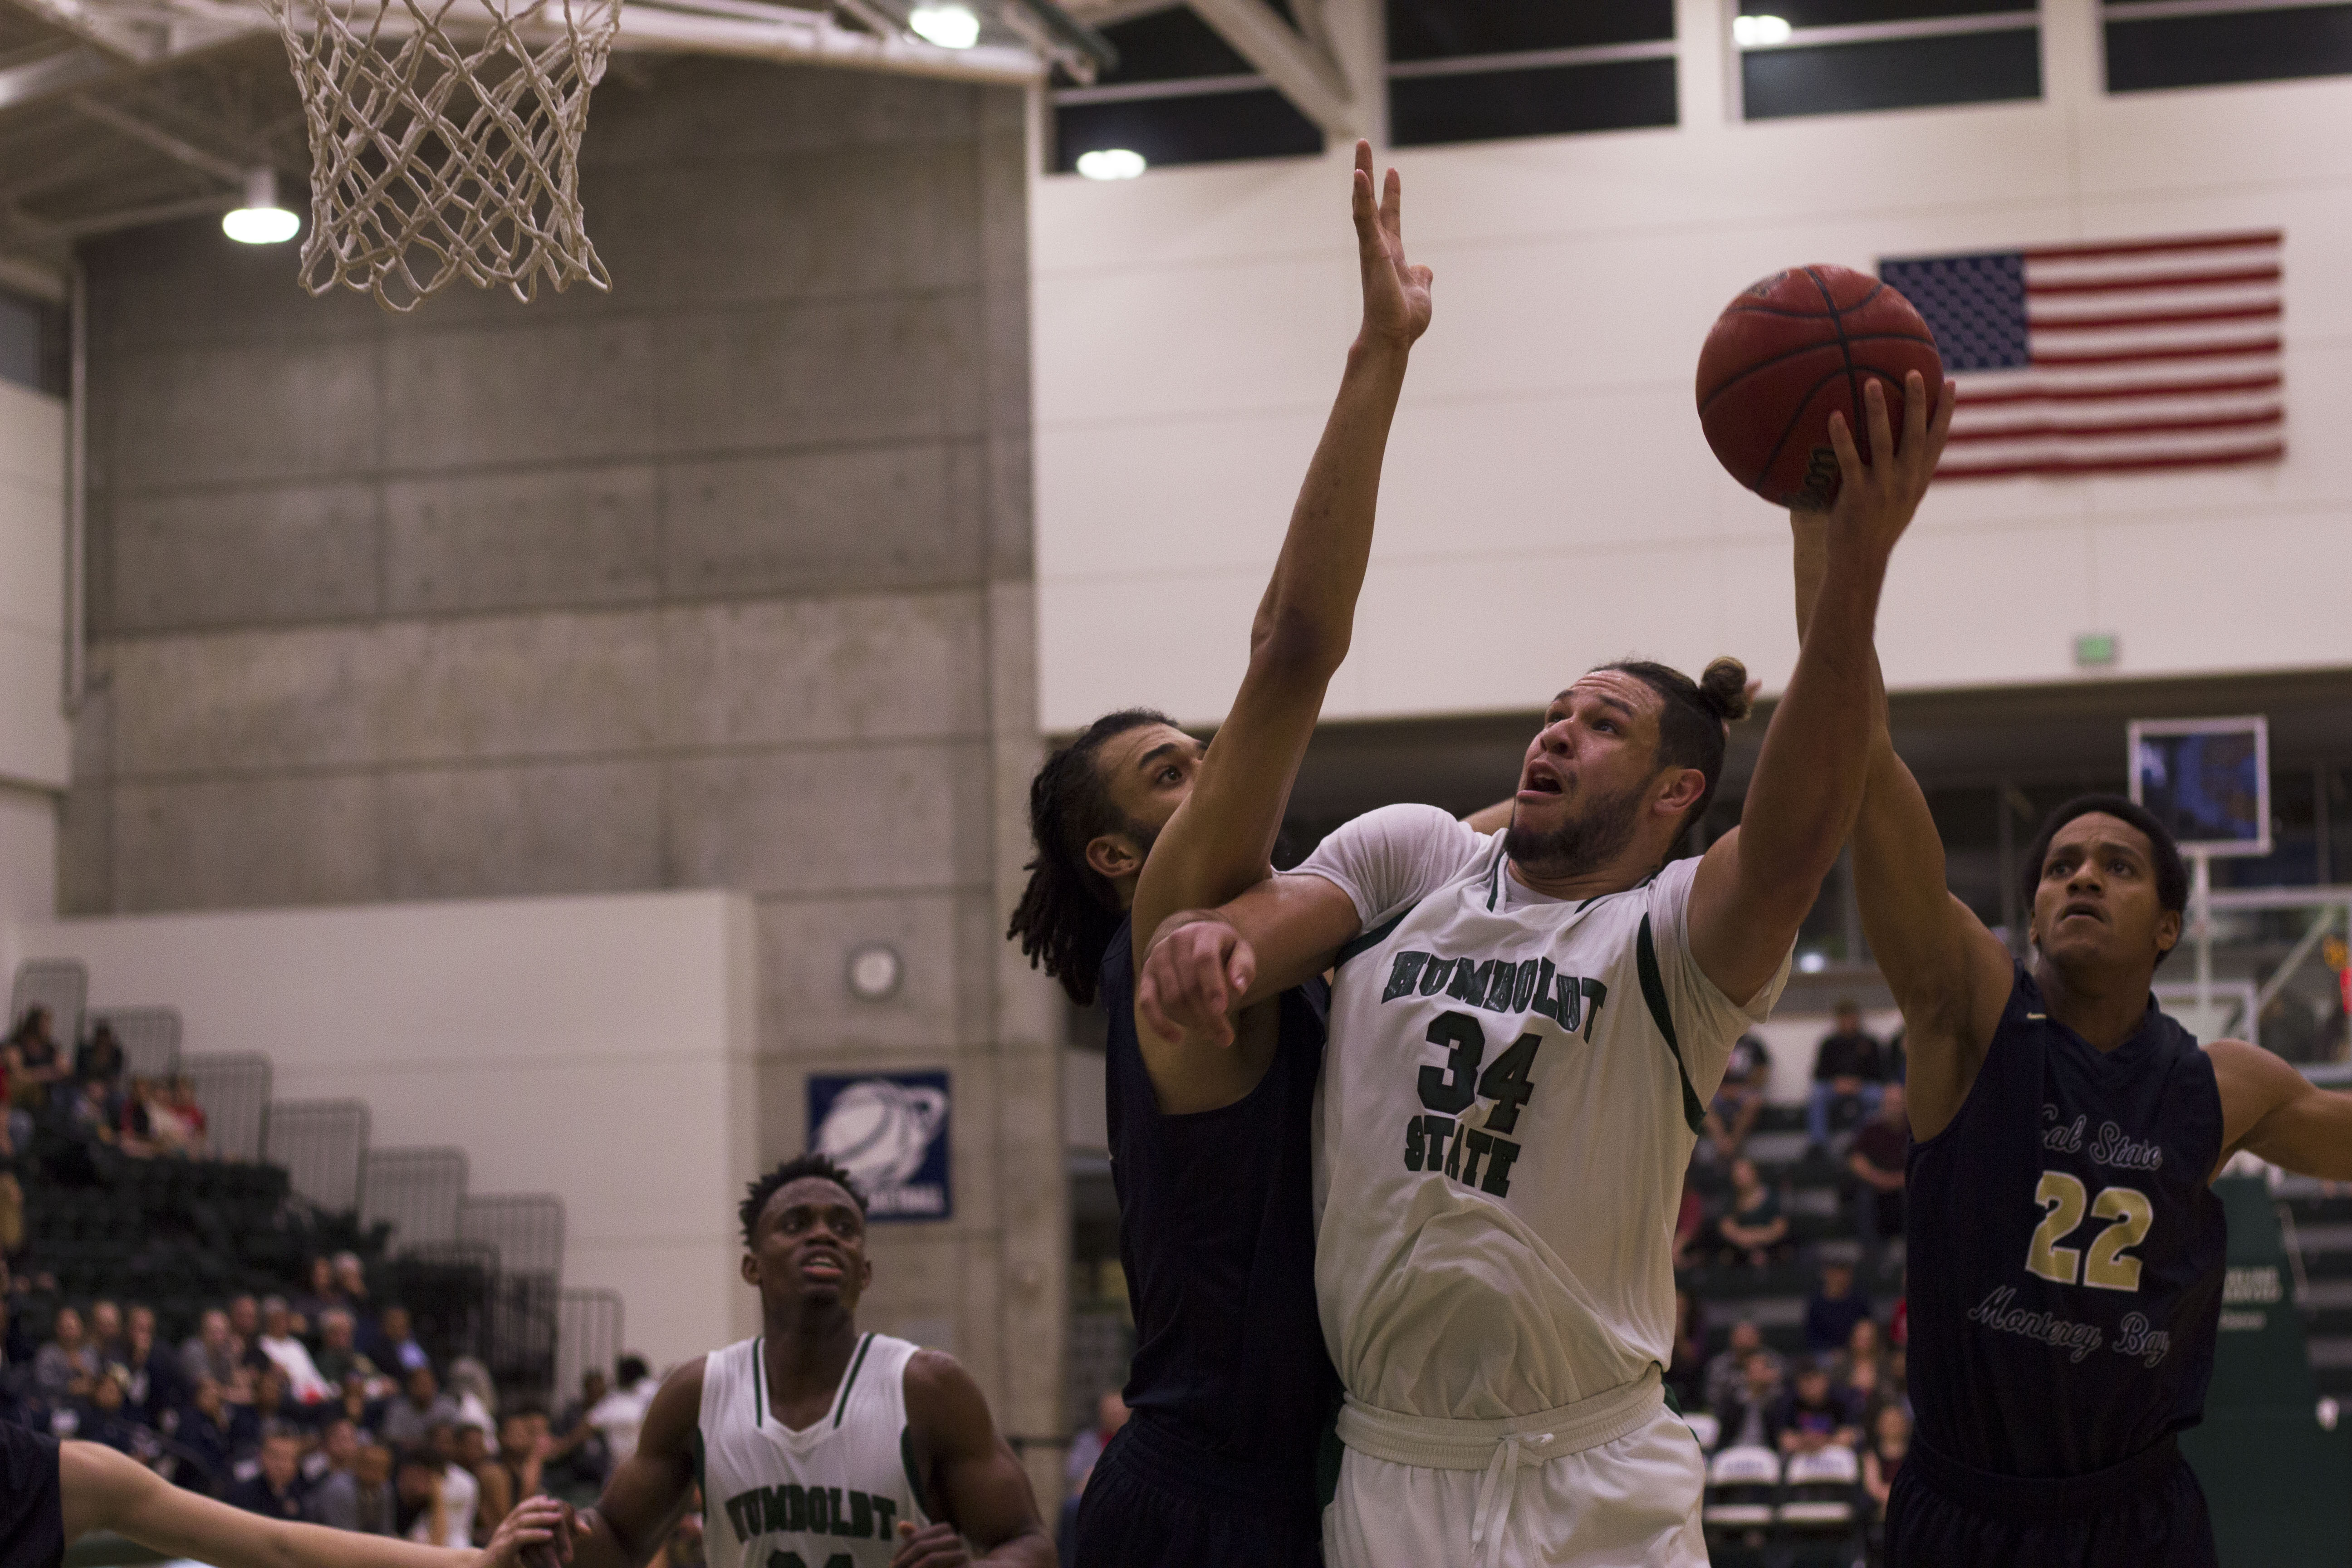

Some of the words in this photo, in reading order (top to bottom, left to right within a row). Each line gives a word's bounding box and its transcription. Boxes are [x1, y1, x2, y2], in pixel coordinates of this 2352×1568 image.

[1381, 951, 1607, 1044] HUMBOLDT
[1417, 1010, 1543, 1135] 34
[1404, 1115, 1521, 1199] STATE
[2090, 1121, 2163, 1170] State
[2025, 1170, 2154, 1292] 22
[1968, 1285, 2103, 1362] Monterey
[2112, 1312, 2171, 1368] Bay
